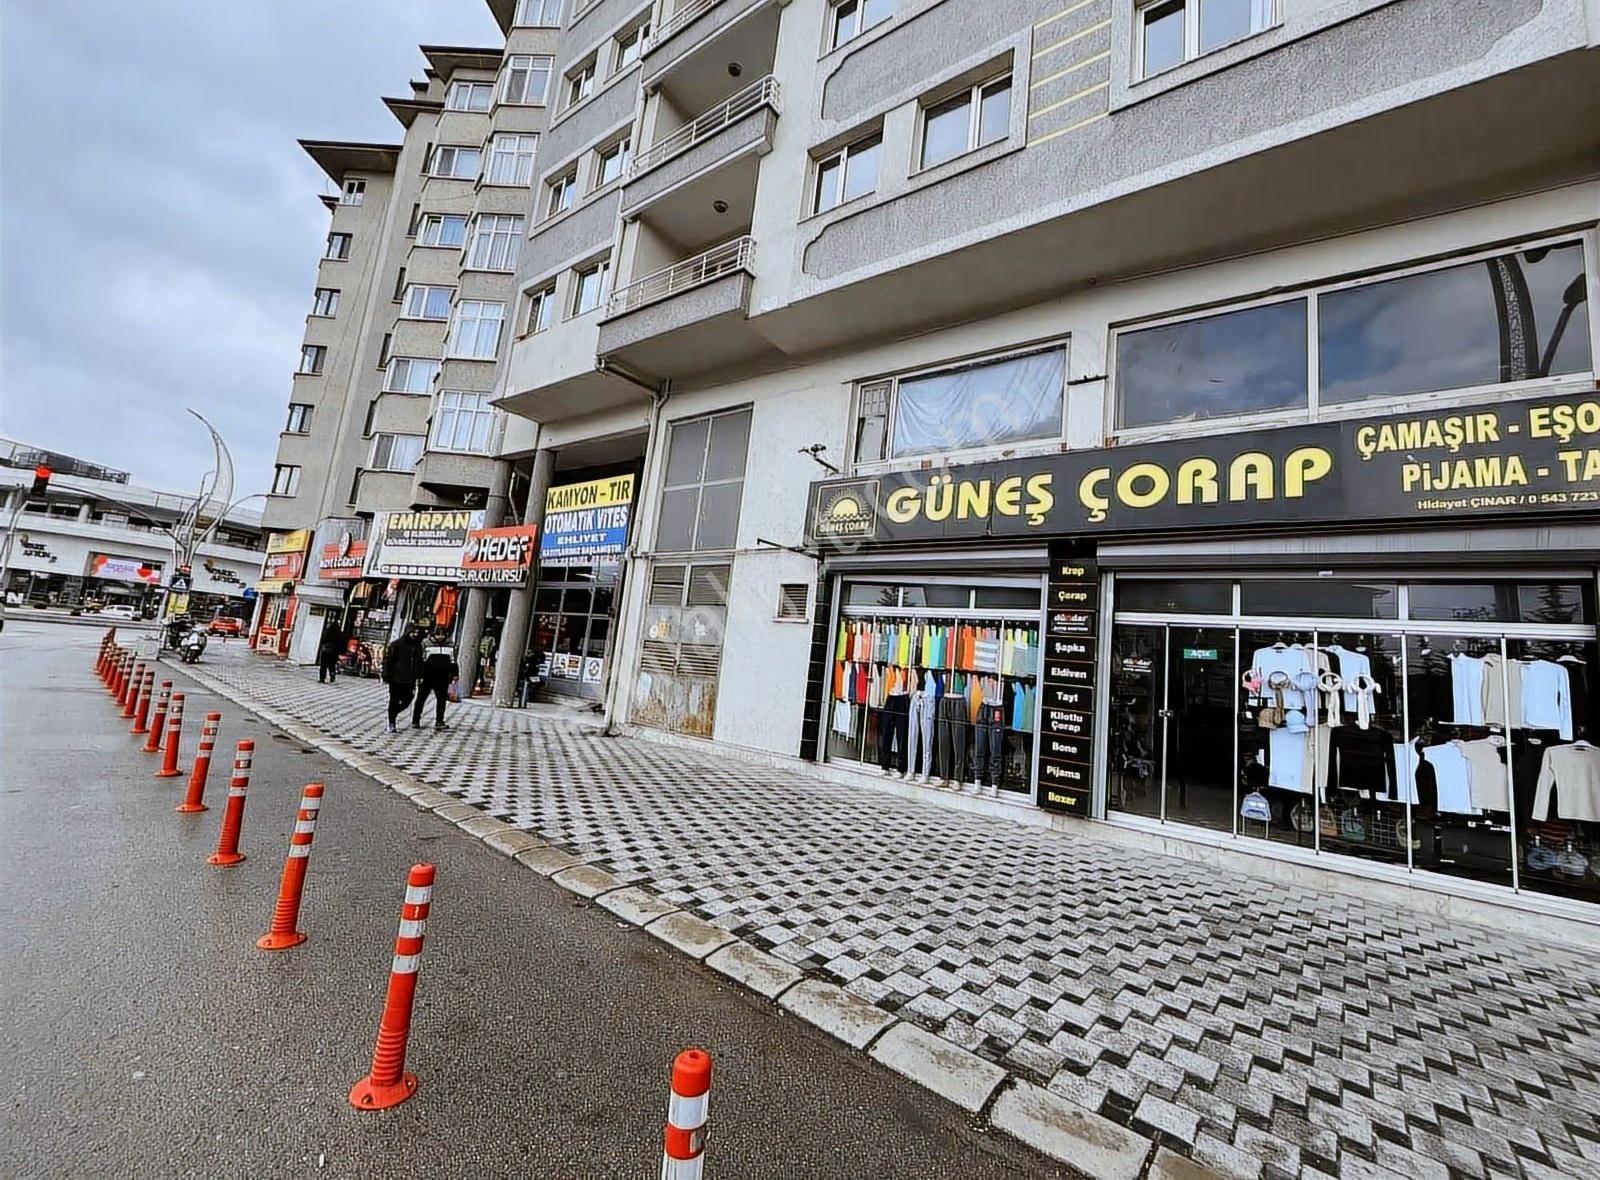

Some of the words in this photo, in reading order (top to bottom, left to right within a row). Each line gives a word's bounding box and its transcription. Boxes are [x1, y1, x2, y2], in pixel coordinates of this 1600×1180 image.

[1357, 413, 1500, 460] ÇAMAŞIR
[1529, 402, 1600, 443] EŞO
[1558, 449, 1600, 482] TA
[886, 474, 1055, 526] GÜNEŞ
[1079, 446, 1333, 523] ÇORAP
[547, 485, 598, 510] KAMYON
[609, 480, 631, 501] TIR
[1417, 498, 1467, 511] Hidayet
[1470, 495, 1517, 508] ÇINAR
[1528, 494, 1537, 504] 0
[1541, 493, 1568, 503] 543
[1570, 491, 1599, 502] 723
[478, 536, 530, 561] HEDEF
[1058, 591, 1087, 602] Çorap
[1055, 642, 1086, 653] Şapka
[1051, 667, 1087, 679] Eldiven
[1056, 691, 1079, 703] Tayt
[1050, 711, 1083, 723] Kilotlu
[1051, 720, 1081, 733] Çorap
[1052, 741, 1078, 754] Bone
[1046, 765, 1081, 780] Pijama
[1048, 791, 1077, 805] Boxer
